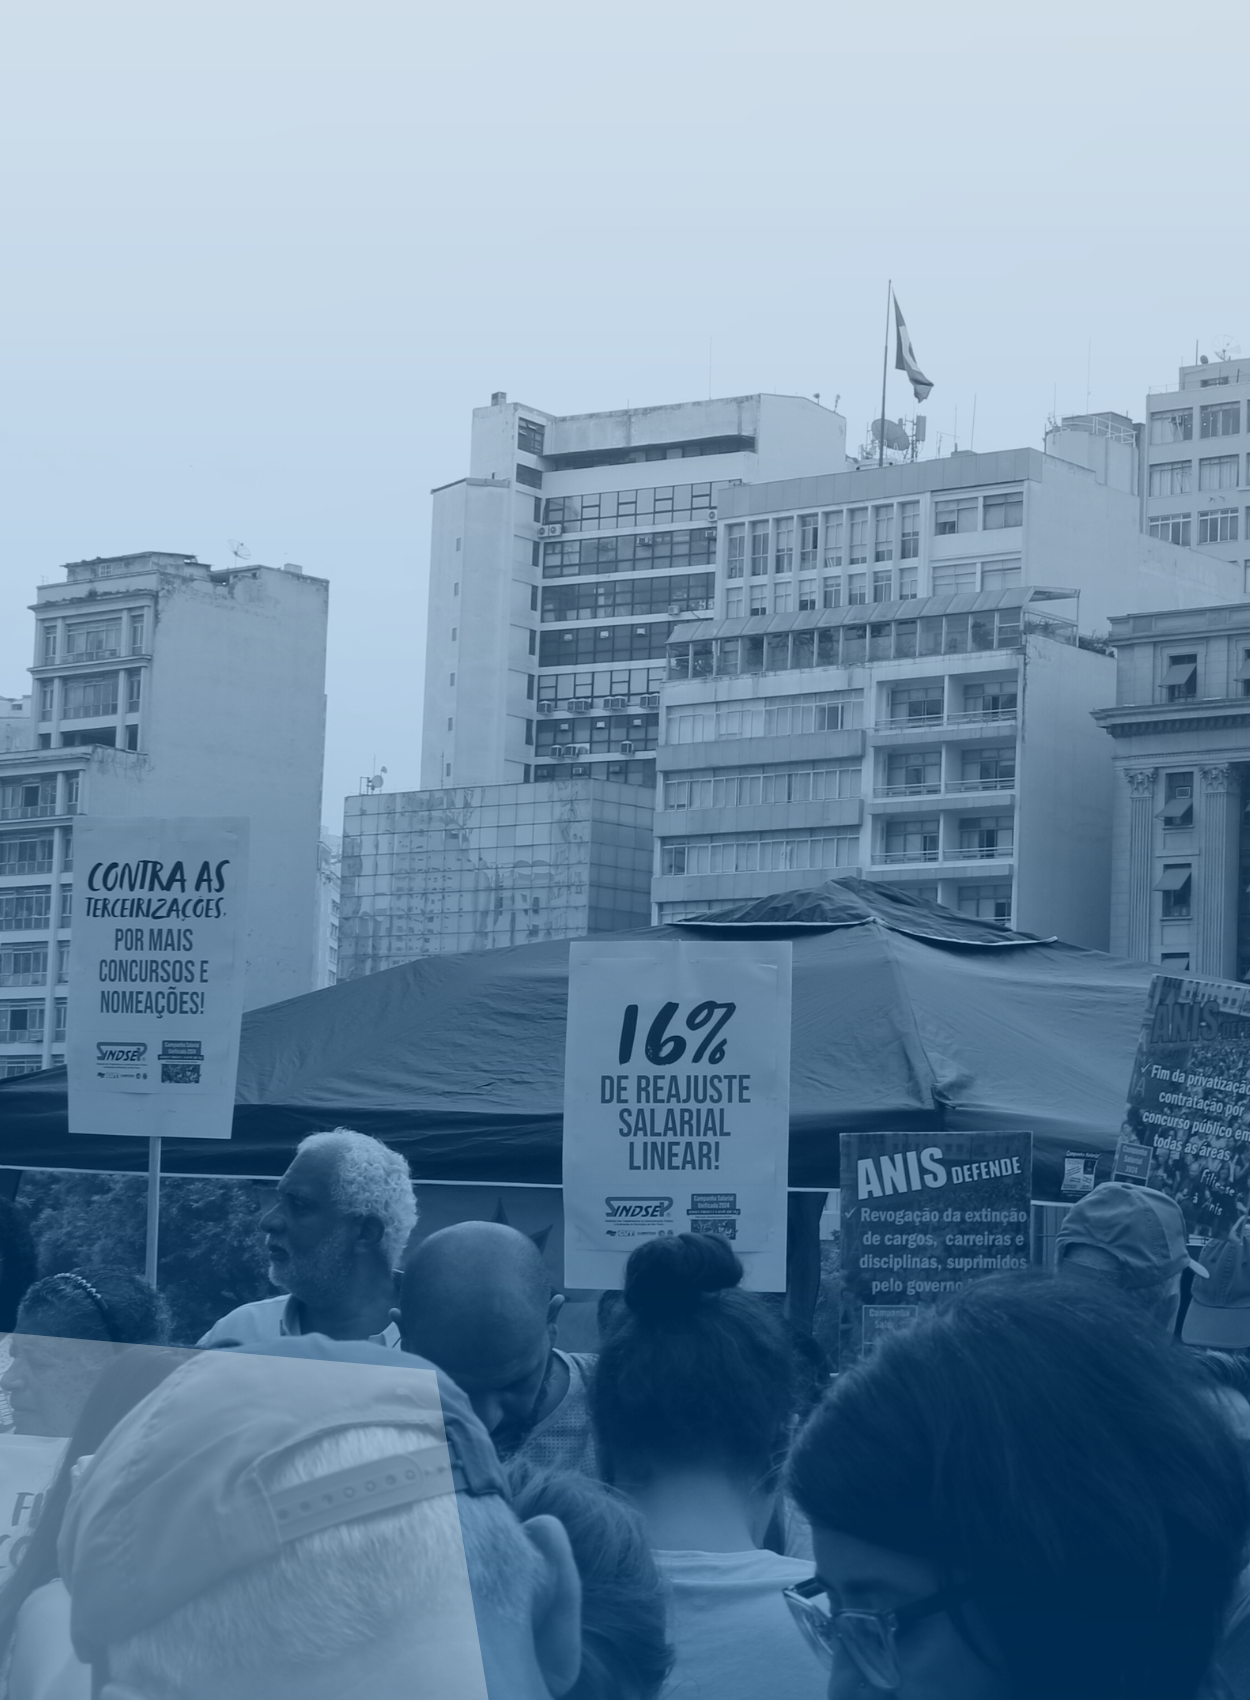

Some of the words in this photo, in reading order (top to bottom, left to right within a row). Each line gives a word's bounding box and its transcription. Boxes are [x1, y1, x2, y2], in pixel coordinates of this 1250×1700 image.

[87, 859, 187, 893] CONTRA
[194, 859, 231, 893] AS
[115, 928, 144, 951] POR
[149, 928, 193, 951] MAIS
[99, 959, 195, 983] CONCURSOS
[200, 960, 209, 983] E
[100, 986, 205, 1019] NOMEAÇÕES!
[618, 1000, 737, 1066] 16%
[1150, 1000, 1220, 1043] ANIS
[1151, 1064, 1171, 1080] Fim
[1171, 1068, 1186, 1083] da
[600, 1075, 629, 1104] DE
[636, 1074, 751, 1104] REAJUSTE
[1158, 1091, 1224, 1114] contratação
[1225, 1103, 1245, 1117] por
[618, 1108, 731, 1138] SALARIAL
[1142, 1111, 1190, 1130] concurso
[1190, 1119, 1233, 1138] público
[628, 1141, 721, 1171] LINEAR!
[1153, 1133, 1182, 1152] todas
[1184, 1142, 1198, 1155] as
[1198, 1141, 1231, 1161] áreas
[857, 1147, 947, 1200] ANIS
[950, 1156, 1022, 1184] DEFENDE
[860, 1207, 942, 1225] Revogação
[943, 1208, 961, 1223] da
[965, 1207, 1028, 1226] extinção
[1201, 1197, 1223, 1216] Anis
[862, 1231, 881, 1246] de
[884, 1234, 938, 1249] cargos,
[945, 1231, 1012, 1246] carreiras
[1015, 1234, 1025, 1246] e
[859, 1254, 942, 1272] disciplinas,
[946, 1254, 1028, 1272] suprimidos
[871, 1277, 903, 1295] pelo
[906, 1280, 964, 1295] governo
